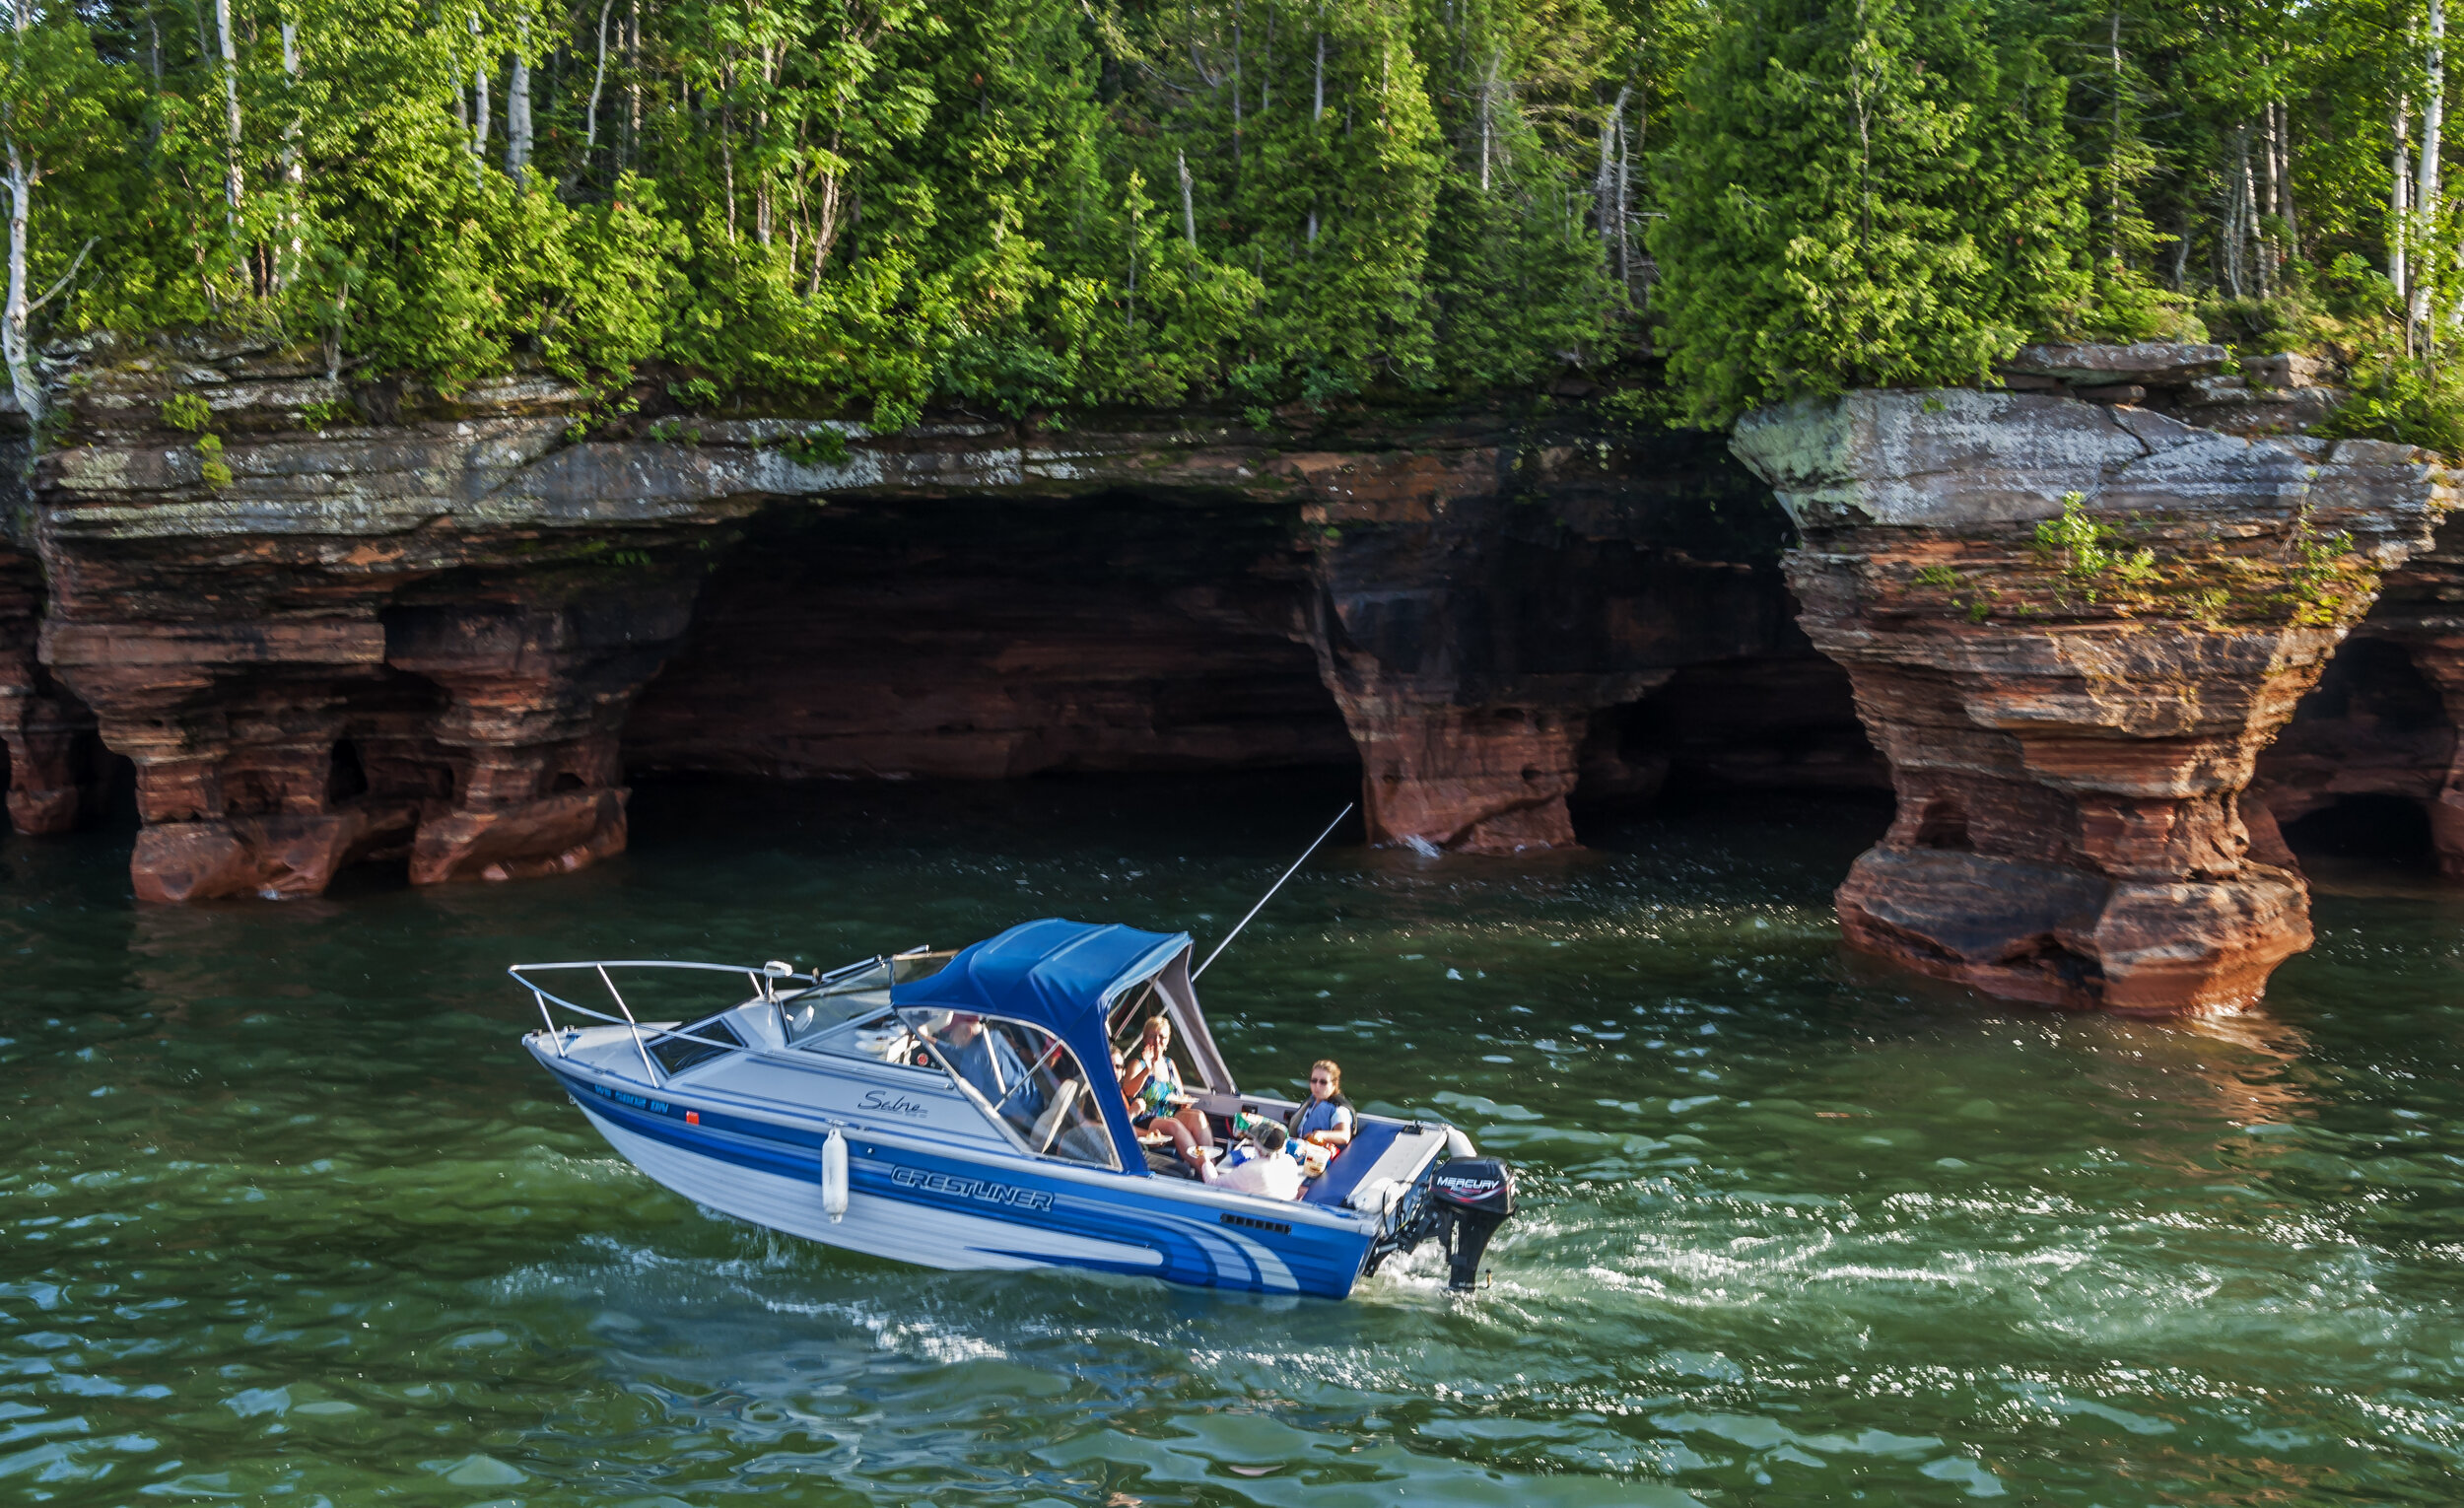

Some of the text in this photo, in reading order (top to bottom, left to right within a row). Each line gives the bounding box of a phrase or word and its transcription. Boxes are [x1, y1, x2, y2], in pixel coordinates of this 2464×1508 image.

[857, 1090, 921, 1112] Sabre
[891, 1166, 1054, 1212] CRESTLINER
[1437, 1176, 1499, 1190] MERCURY
